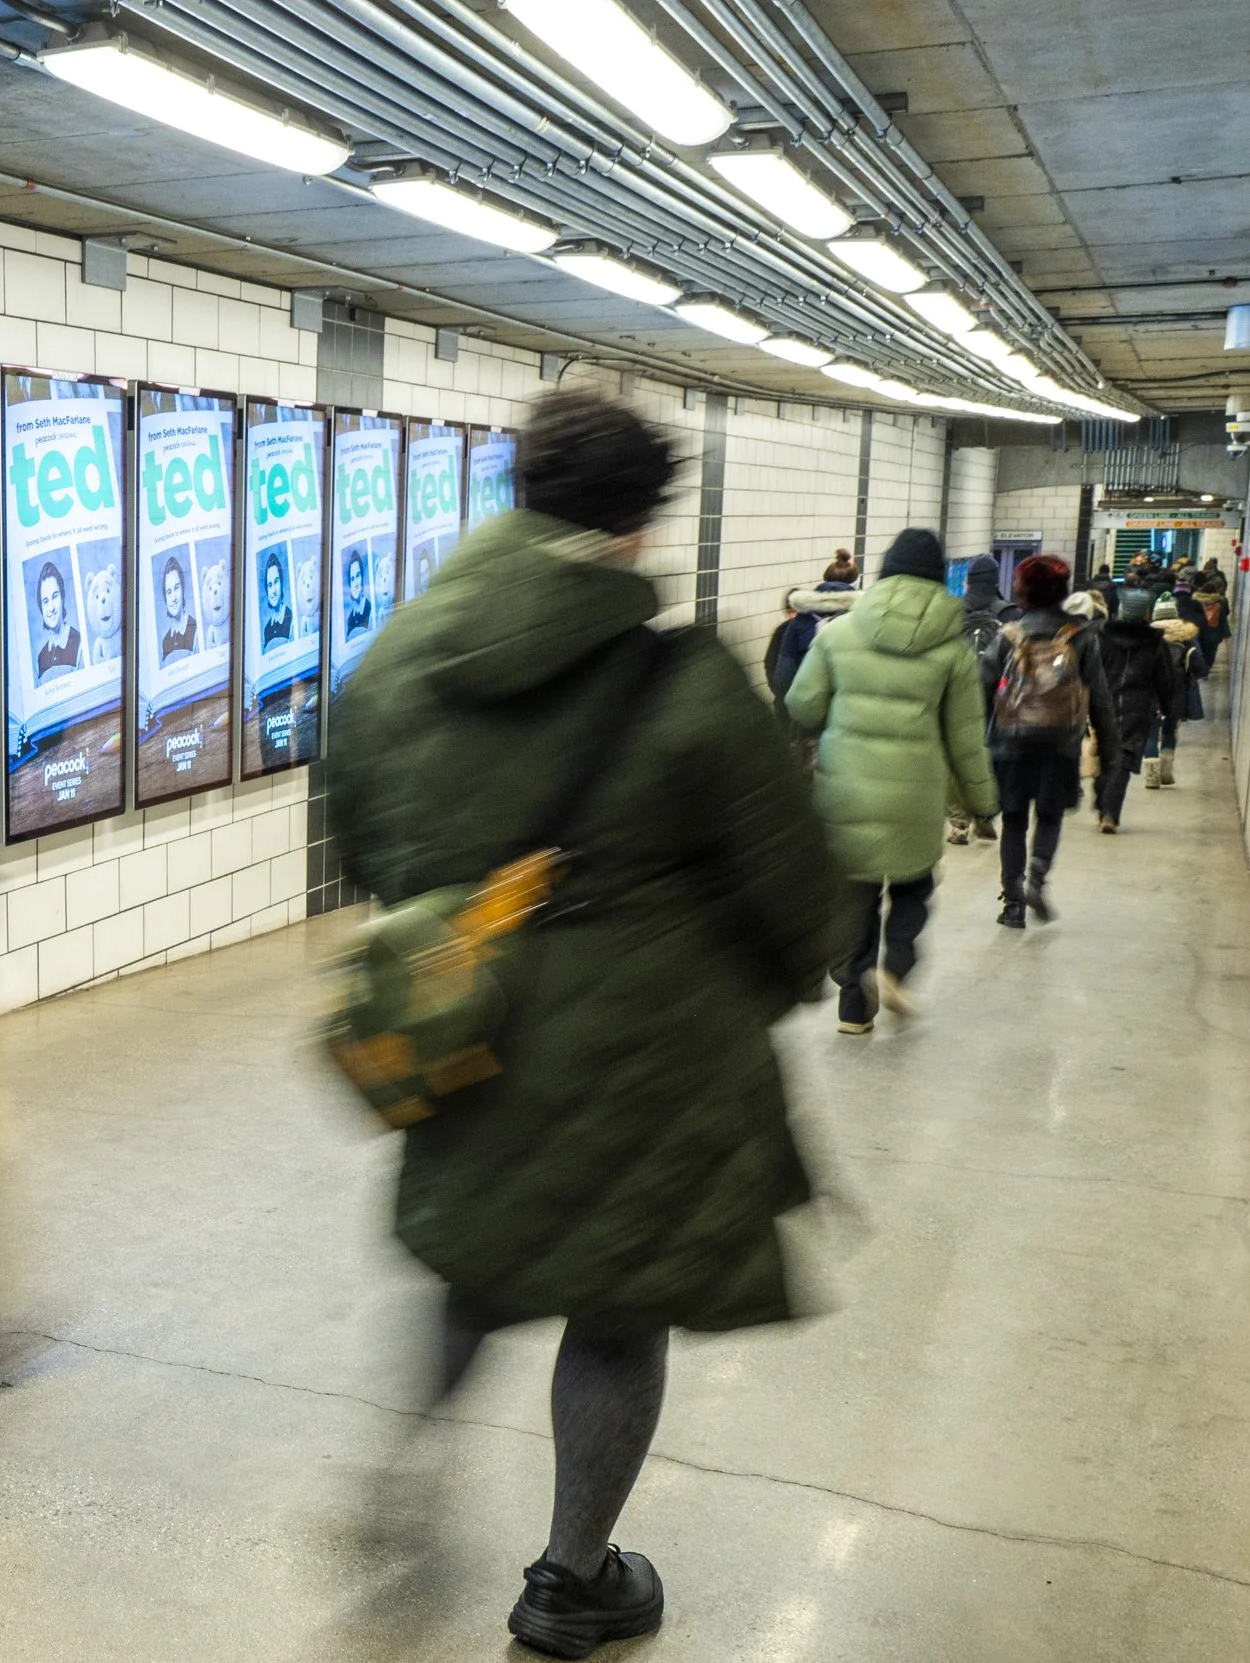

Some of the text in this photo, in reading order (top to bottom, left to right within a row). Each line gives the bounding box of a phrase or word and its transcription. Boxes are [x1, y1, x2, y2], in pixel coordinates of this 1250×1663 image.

[16, 414, 91, 434] from Seth MacFarlane
[148, 425, 208, 442] from Seth MacFarlane
[10, 425, 115, 528] ted
[142, 434, 226, 526] ted
[249, 443, 317, 525] ted
[336, 449, 393, 525] ted
[409, 454, 457, 525] ted
[471, 460, 512, 523] ted
[266, 710, 295, 736] peacock
[166, 727, 200, 758] peacock
[172, 753, 184, 762] EVENT
[44, 752, 86, 786] peacock
[176, 760, 192, 772] JAN 11
[52, 776, 82, 791] EVENT SERIES
[57, 787, 76, 801] JAN 11
